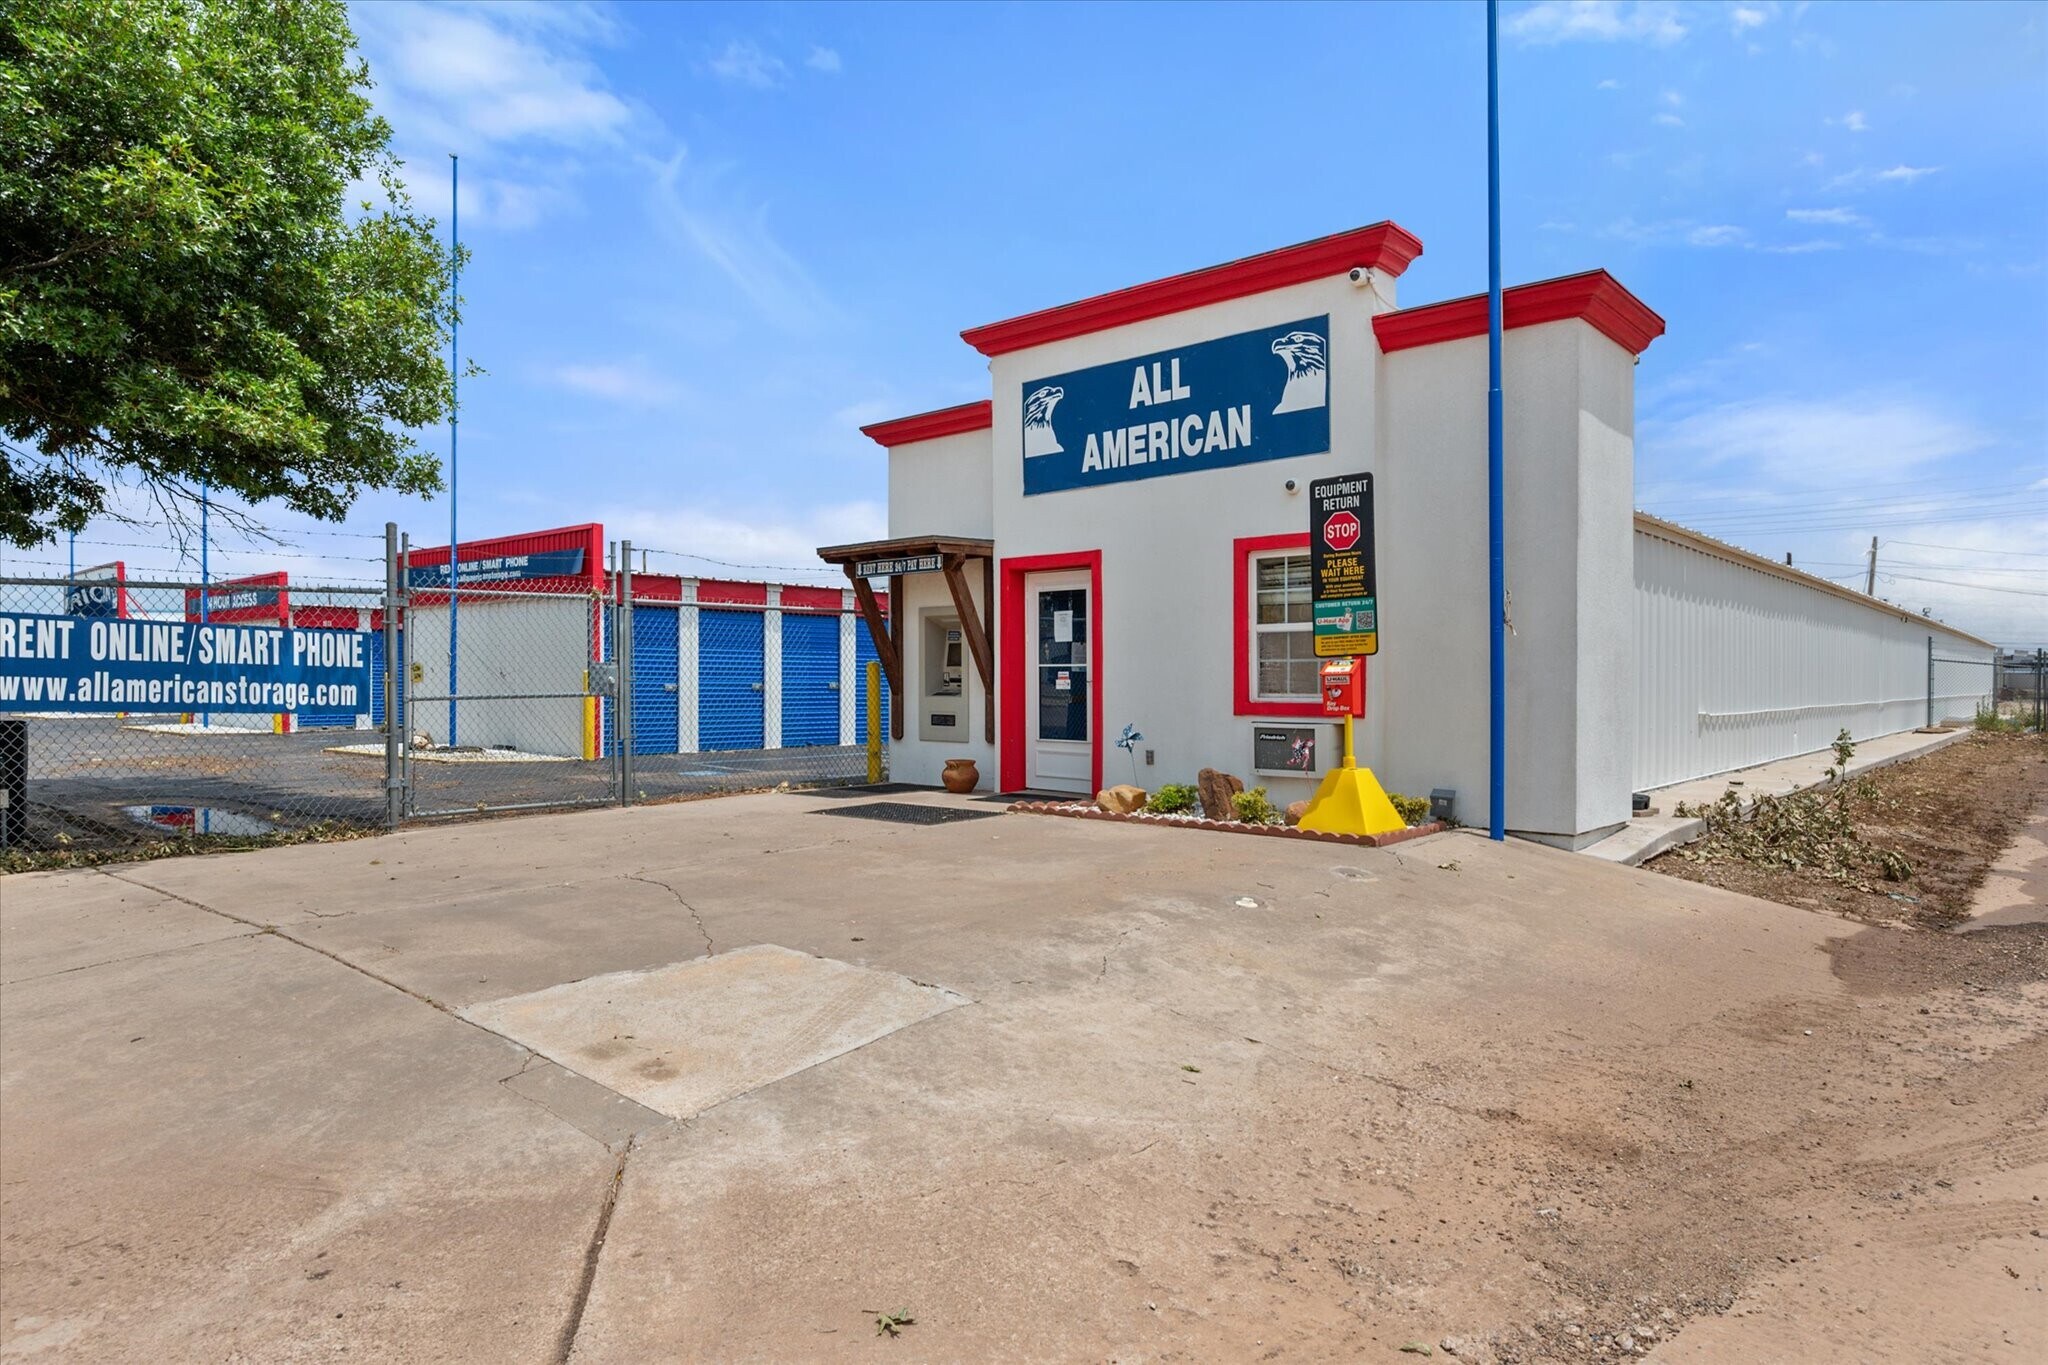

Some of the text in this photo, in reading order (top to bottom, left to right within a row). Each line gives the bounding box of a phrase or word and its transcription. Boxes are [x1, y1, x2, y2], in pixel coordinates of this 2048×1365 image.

[1129, 358, 1191, 409] ALL
[1081, 404, 1251, 473] AMERICAN
[1315, 480, 1368, 498] EQUIPMENT
[1323, 495, 1360, 511] RETURN
[1327, 523, 1357, 539] STOP
[505, 556, 529, 568] PHONE
[877, 561, 893, 573] HERE
[907, 559, 918, 571] PAY
[918, 557, 936, 569] HERE
[1327, 557, 1358, 568] PLEASE
[1320, 565, 1365, 577] WAIT HERE
[0, 617, 364, 668] RENT ONLINE/SMART PHONE
[0, 671, 357, 710] www.allamericanstorage.com
